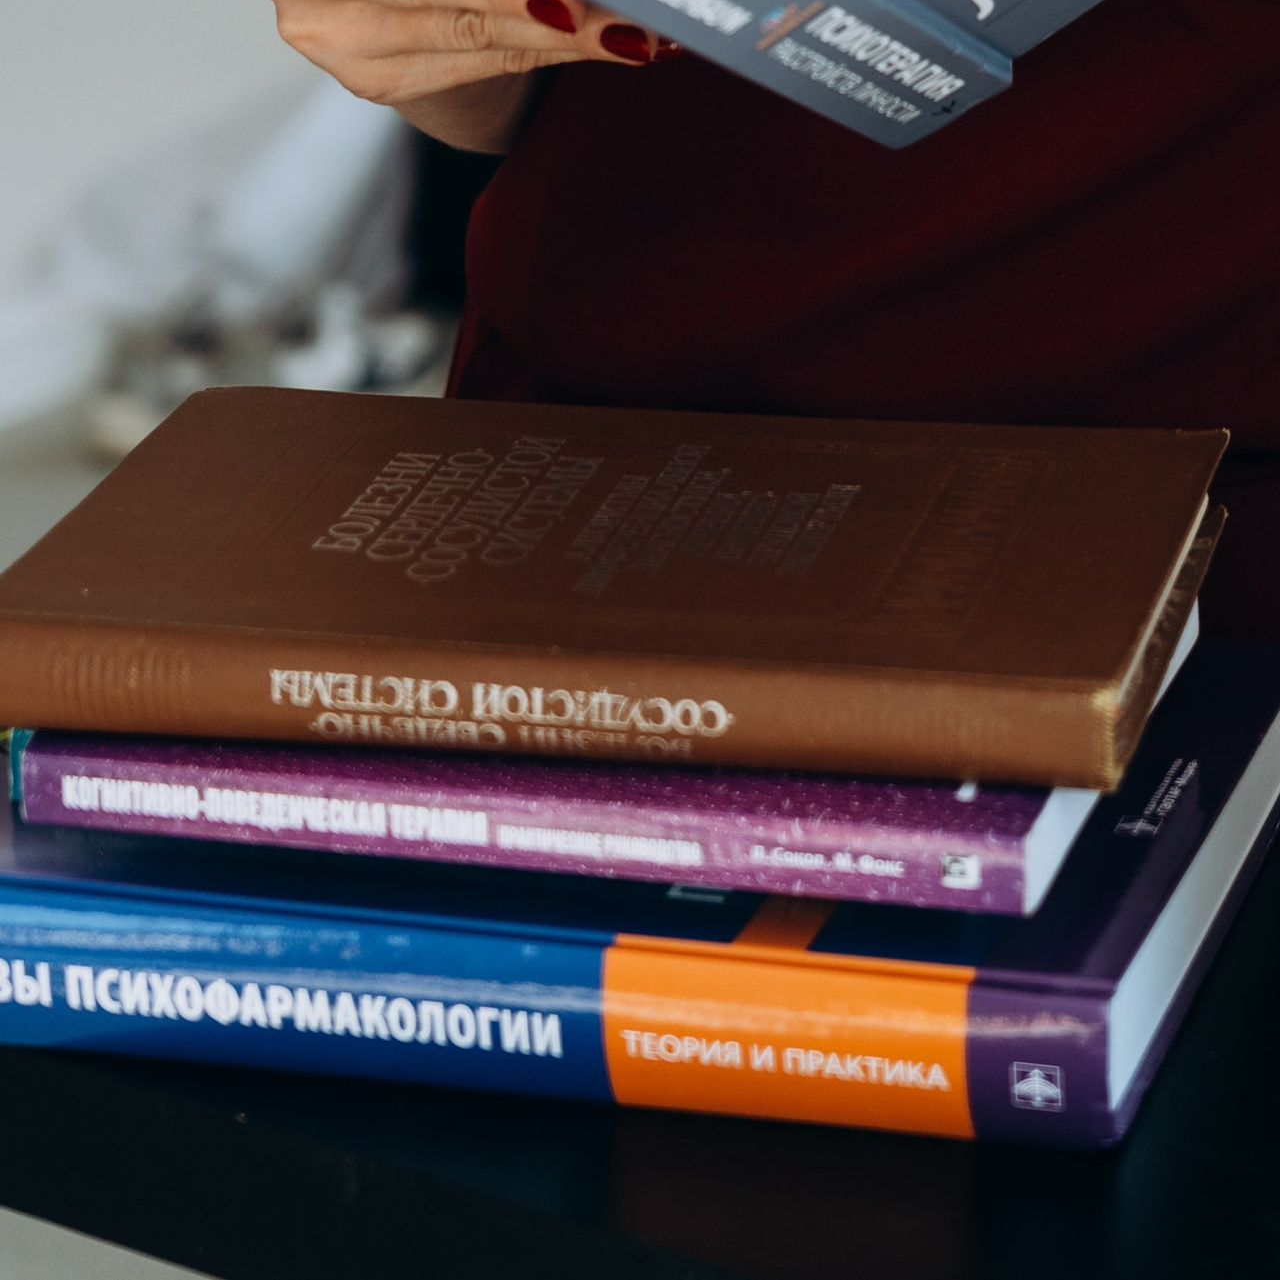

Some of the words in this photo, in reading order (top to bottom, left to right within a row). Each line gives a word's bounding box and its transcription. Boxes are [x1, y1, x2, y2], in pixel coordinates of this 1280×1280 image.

[805, 5, 965, 102] ПСИХОТЕРАПИЯ
[311, 451, 442, 553] БОЛЕЗНИ
[481, 455, 605, 564] СИСТЕМЫ
[270, 669, 460, 716] СИСТЕМЫ
[388, 803, 489, 847] ТЕРАПИЯ
[64, 964, 563, 1059] ПСИХОФАРМАКОЛОГИИ
[621, 1029, 741, 1066] ТЕОРИЯ
[750, 1044, 775, 1073] И
[783, 1047, 951, 1092] ПРАКТИКА
